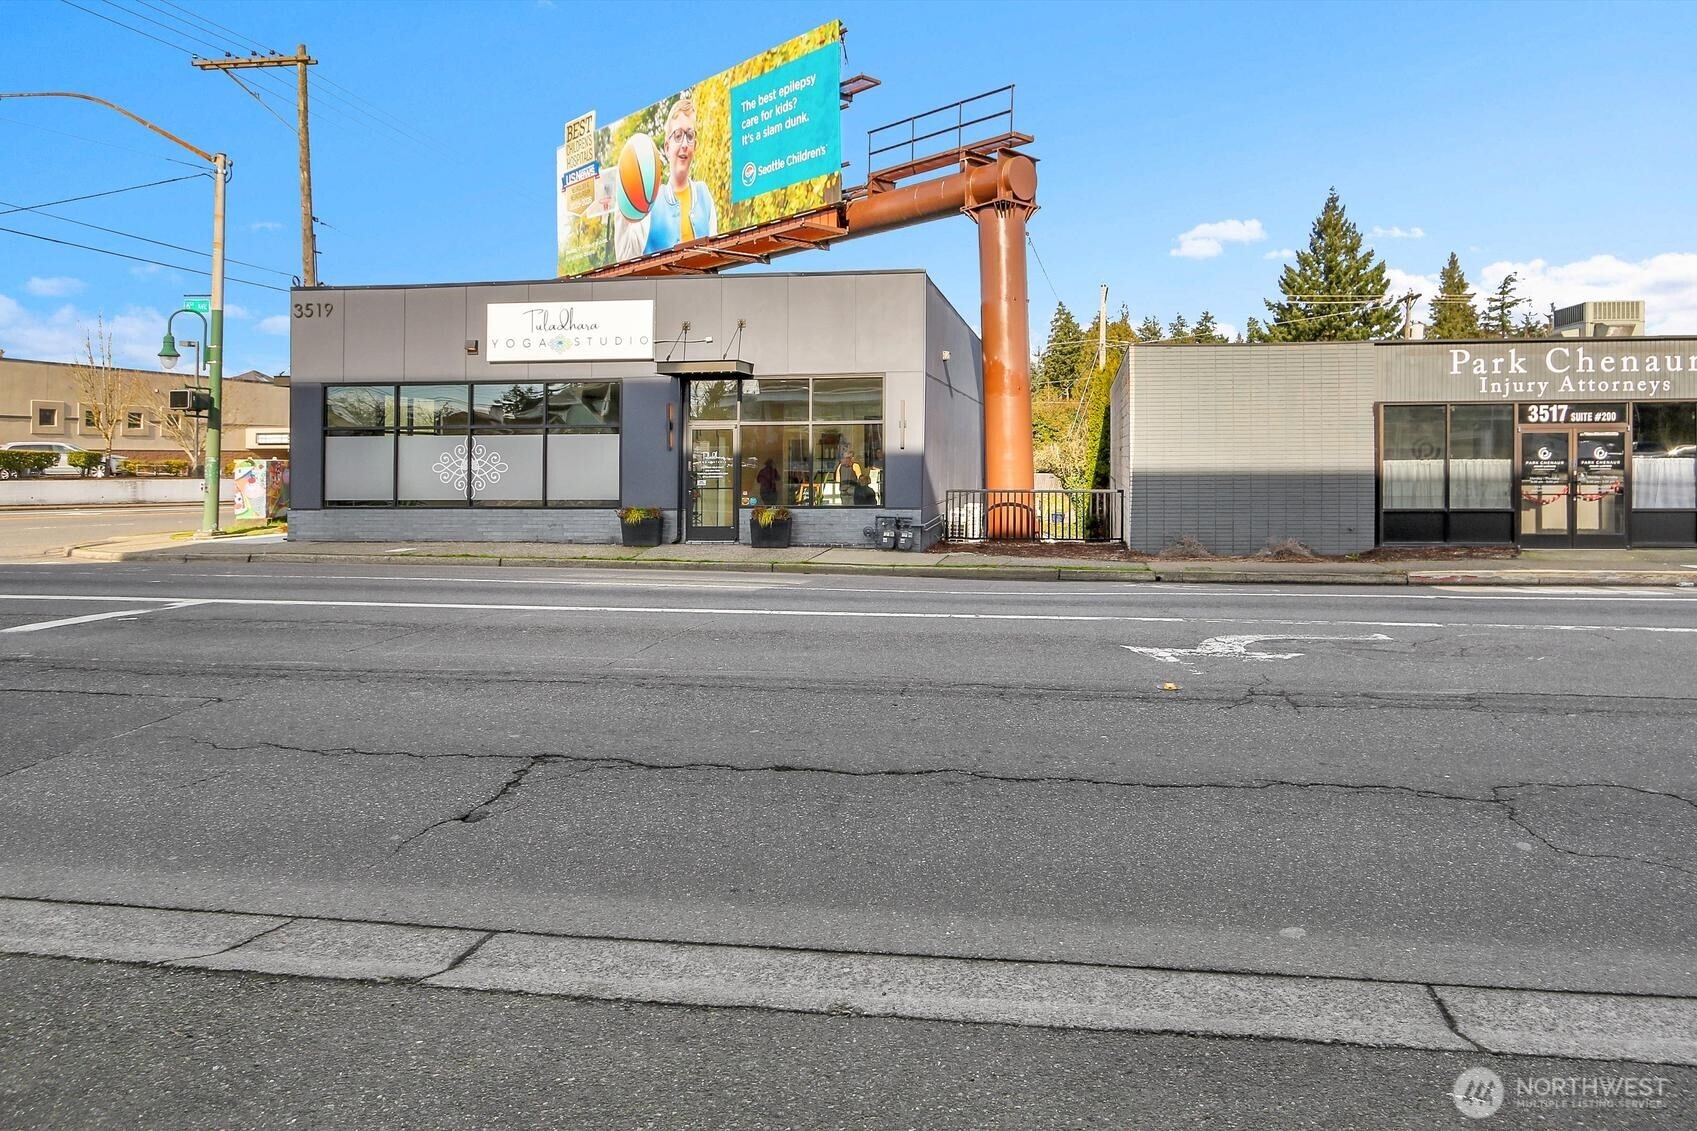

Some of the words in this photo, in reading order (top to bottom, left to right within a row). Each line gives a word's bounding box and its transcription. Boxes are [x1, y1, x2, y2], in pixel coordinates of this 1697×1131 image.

[741, 100, 756, 113] The
[758, 89, 777, 106] best
[779, 73, 816, 97] epilepsy
[741, 115, 759, 129] care
[760, 109, 773, 122] for
[775, 97, 798, 116] kids?
[566, 115, 593, 143] BEST
[741, 133, 754, 146] It's
[755, 132, 761, 140] a
[763, 122, 783, 138] slam
[785, 112, 809, 129] dunk.
[566, 148, 593, 169] HOSPITALS
[758, 159, 785, 176] Seattle
[786, 146, 826, 166] Children's
[293, 303, 334, 318] 3519
[522, 307, 599, 333] Tuladhara
[491, 338, 547, 349] YOGA
[574, 336, 649, 346] STUDIO
[1449, 348, 1528, 375] Park
[1545, 347, 1697, 374] Chenaur
[1479, 376, 1550, 398] Injury
[1558, 375, 1671, 397] Attorneys
[1528, 404, 1568, 422] 3517
[1571, 411, 1593, 422] SUITE
[1594, 411, 1617, 422] #200
